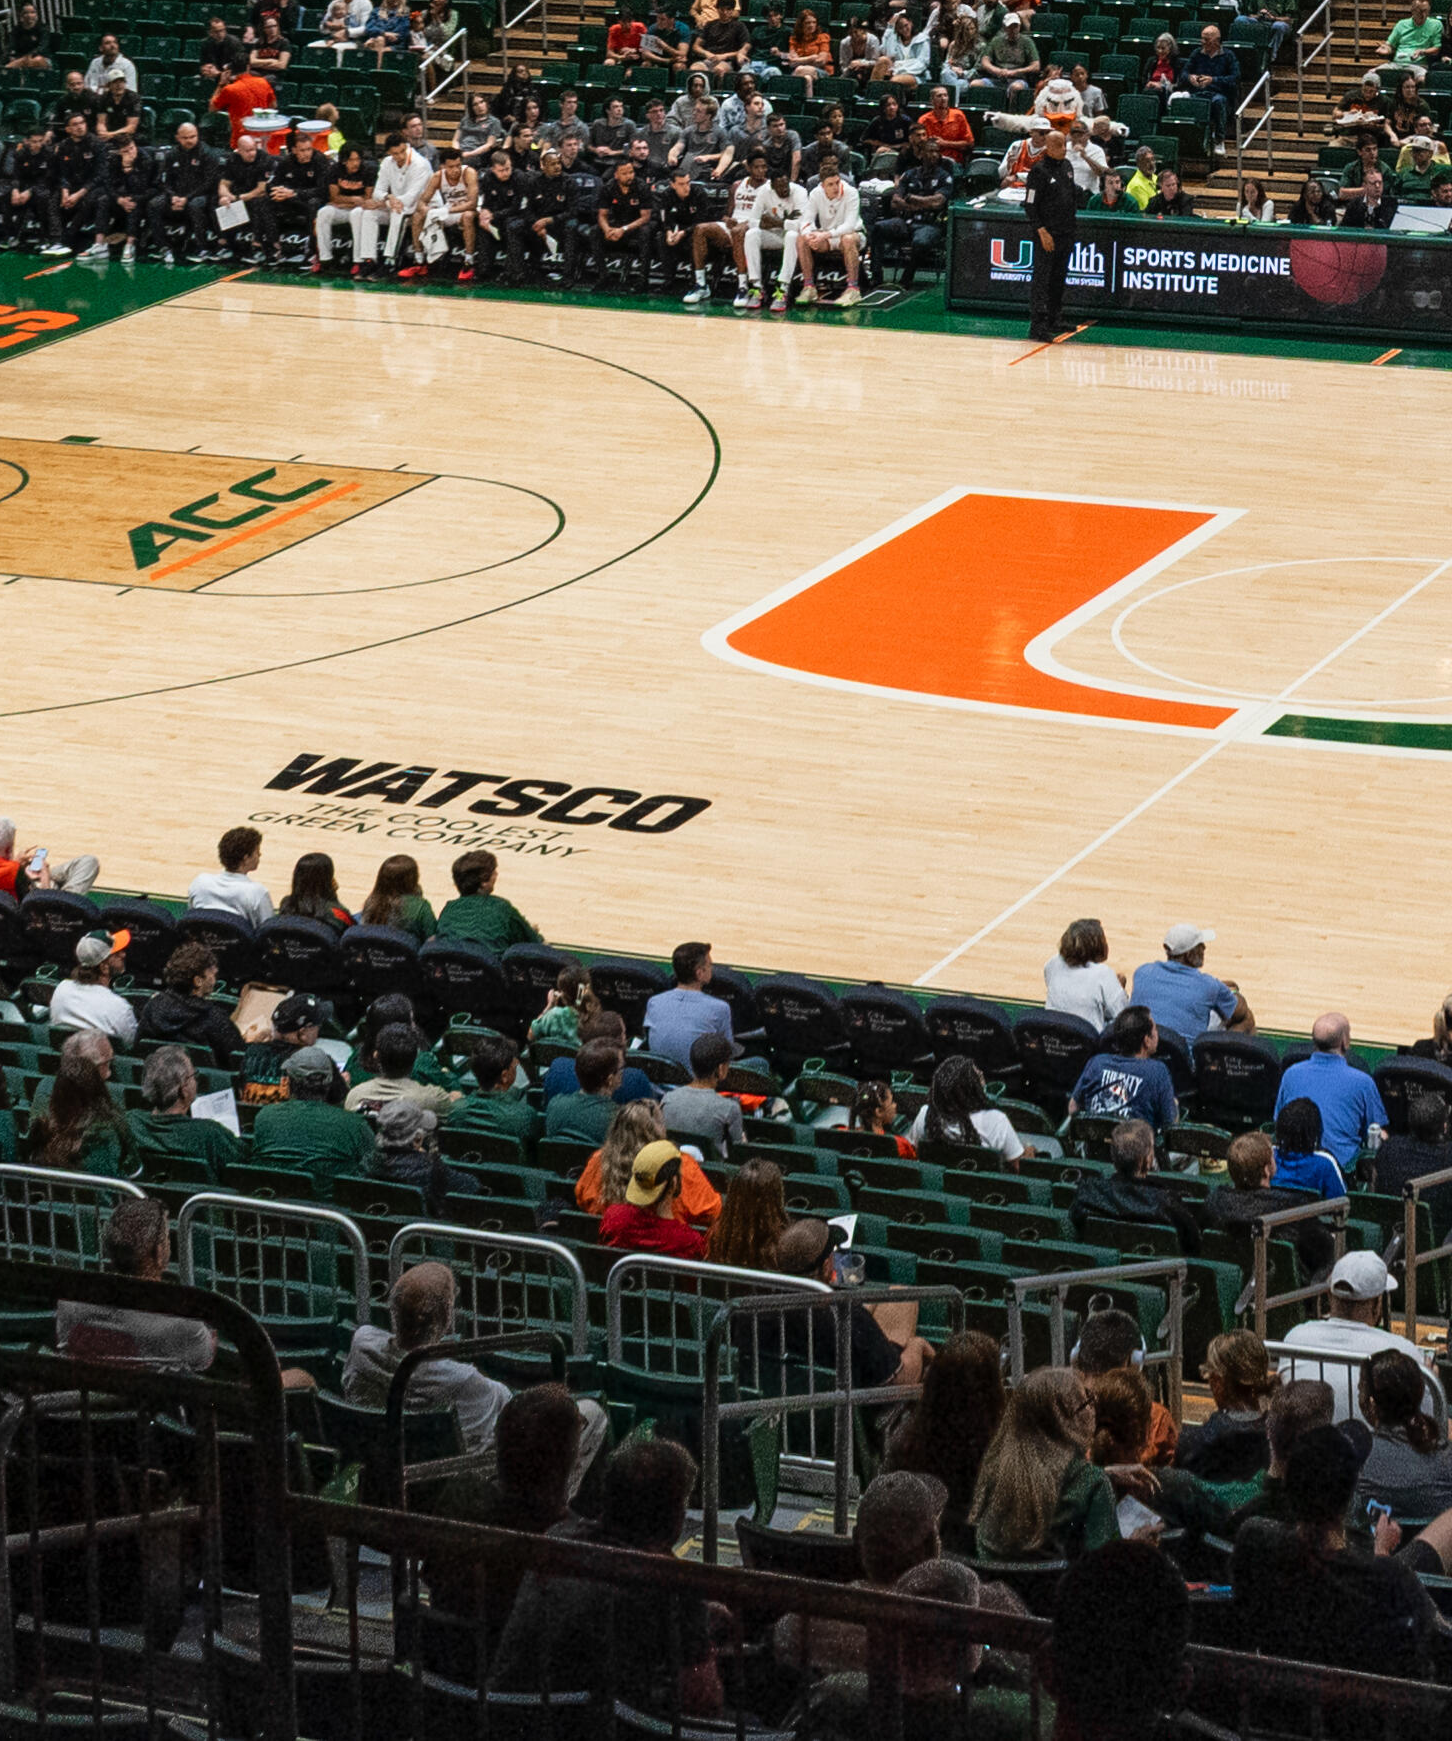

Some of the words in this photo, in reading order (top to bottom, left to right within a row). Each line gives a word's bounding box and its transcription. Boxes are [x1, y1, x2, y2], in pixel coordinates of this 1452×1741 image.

[1123, 247, 1196, 269] SPORTS
[1201, 253, 1291, 276] MEDICINE
[1123, 271, 1219, 295] INSTITUTE
[128, 466, 335, 571] ACC
[264, 753, 712, 834] WATSCO
[247, 810, 379, 835] GREEN
[386, 823, 590, 858] COMPANY
[302, 801, 385, 821] THE
[388, 811, 574, 843] COOLEST
